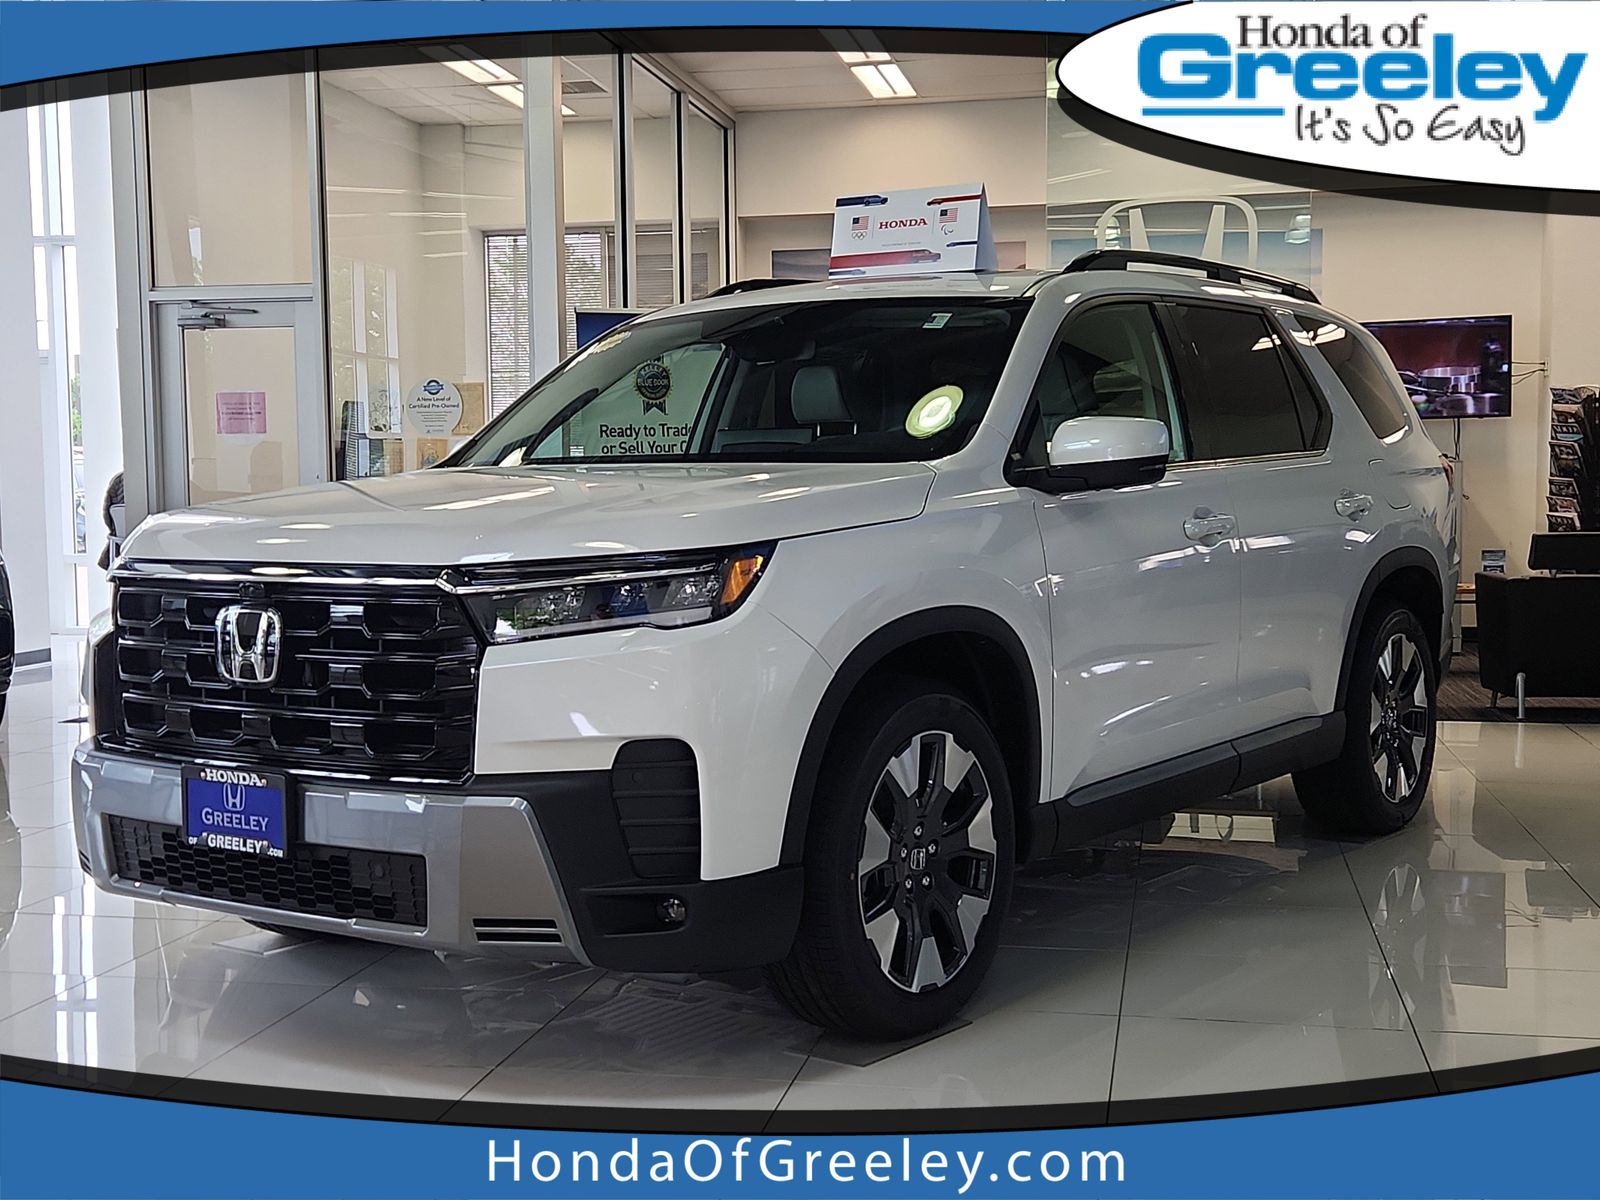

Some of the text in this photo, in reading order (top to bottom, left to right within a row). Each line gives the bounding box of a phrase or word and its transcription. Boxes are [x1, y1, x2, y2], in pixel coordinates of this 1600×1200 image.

[878, 217, 928, 230] HONDA
[599, 423, 641, 440] Ready
[643, 425, 656, 437] to
[601, 444, 616, 455] or
[618, 441, 645, 454] Sell
[647, 440, 677, 454] Your
[204, 768, 263, 787] HONDA
[201, 807, 269, 832] GREELEY
[188, 836, 198, 845] OF
[207, 833, 262, 854] GREELEY
